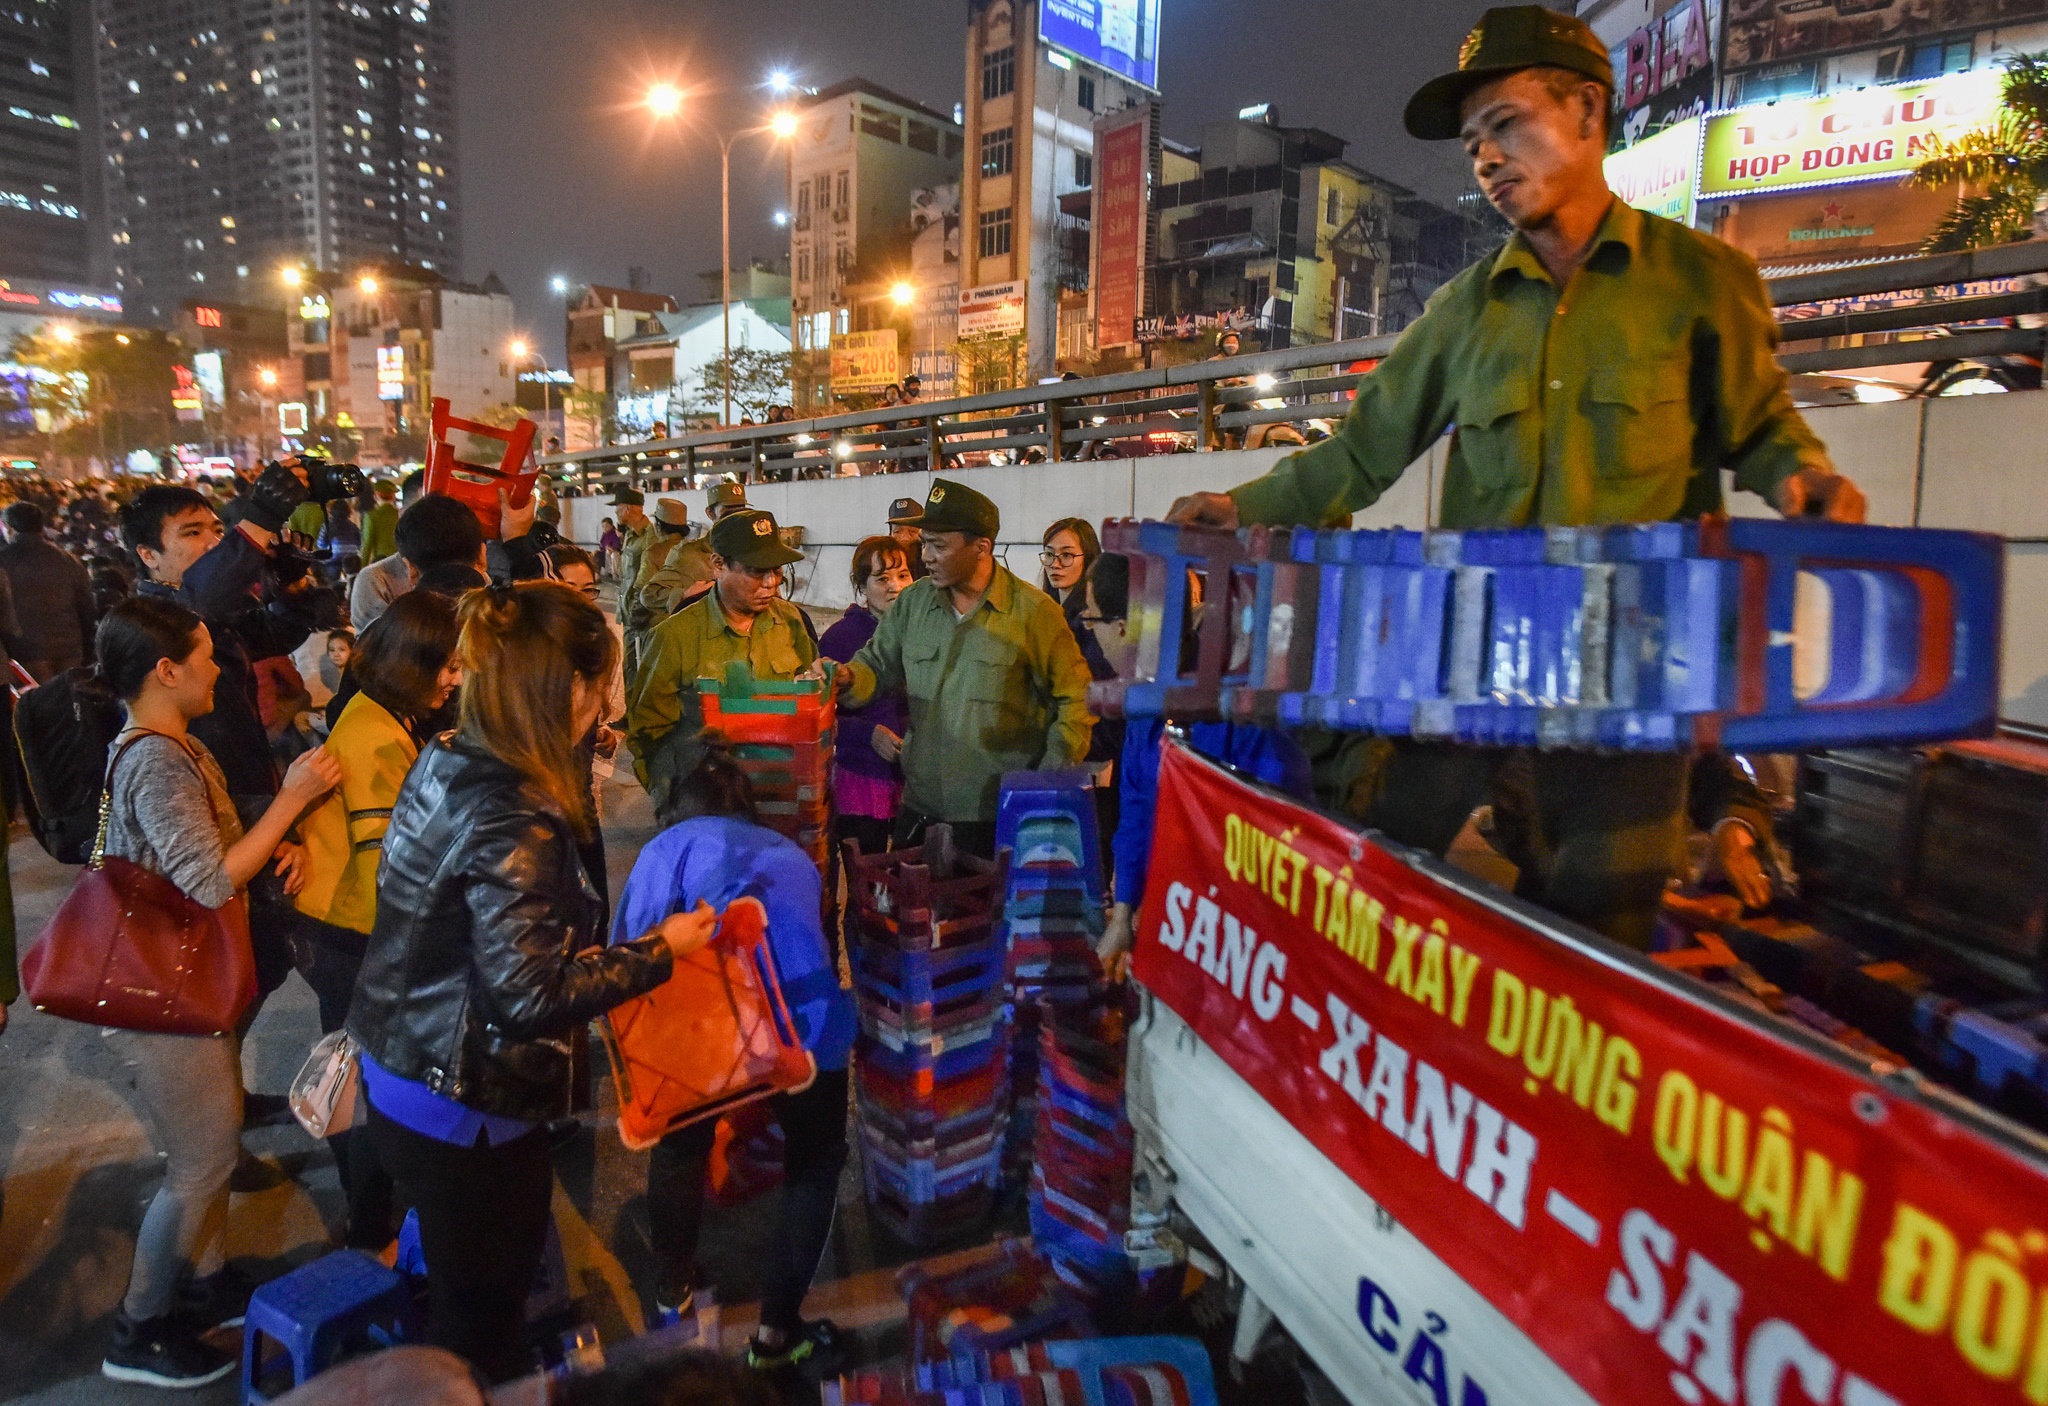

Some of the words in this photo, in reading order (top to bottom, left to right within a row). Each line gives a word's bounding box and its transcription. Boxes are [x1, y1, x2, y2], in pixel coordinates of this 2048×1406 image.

[1625, 0, 1708, 109] BI-A
[1789, 225, 1874, 242] Heineken
[1137, 320, 1157, 331] 317
[862, 350, 896, 375] 2018
[1224, 813, 1308, 917] QUYẾT
[1313, 864, 1385, 973] TÂM
[1385, 916, 1481, 1028] XÂY
[1486, 967, 1642, 1136] DỰNG
[1653, 1070, 1866, 1282] QUẬN
[1878, 1204, 2048, 1406] ĐỐ
[1159, 881, 1287, 1021] SÁNG
[1319, 992, 1538, 1232] XANH
[1606, 1208, 1900, 1406] SẠC
